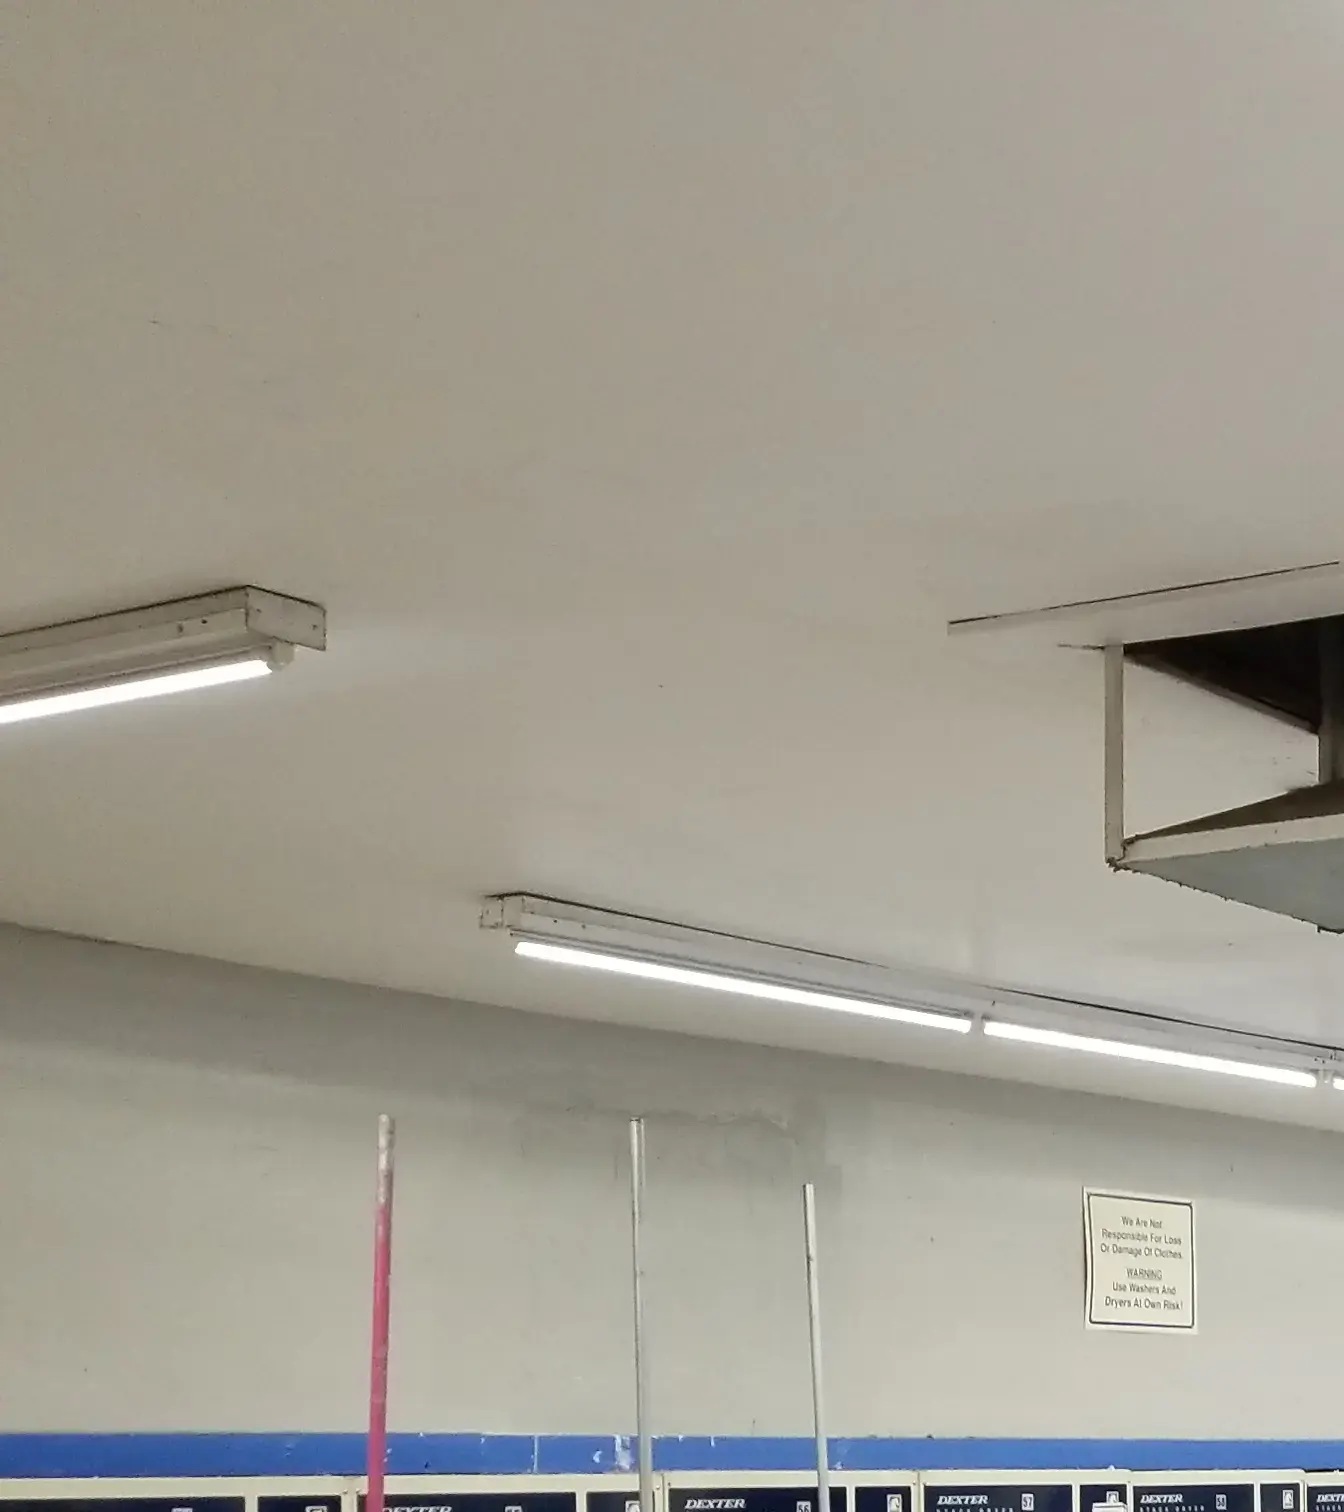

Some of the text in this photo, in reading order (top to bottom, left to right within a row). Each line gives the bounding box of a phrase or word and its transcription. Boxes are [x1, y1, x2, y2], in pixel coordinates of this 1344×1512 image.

[1121, 1216, 1133, 1226] We
[1136, 1218, 1148, 1228] Are
[1102, 1228, 1182, 1245] Responsible For Loss
[1112, 1244, 1142, 1257] Damage
[1127, 1268, 1163, 1280] WARNING
[1113, 1281, 1177, 1295] Use Washers And
[1105, 1296, 1132, 1309] Dryers
[1145, 1299, 1161, 1309] Own
[685, 1498, 746, 1510] DEXTER
[937, 1495, 989, 1505] DEXTER
[1022, 1495, 1033, 1510] 57
[1140, 1493, 1183, 1503] DEXTER
